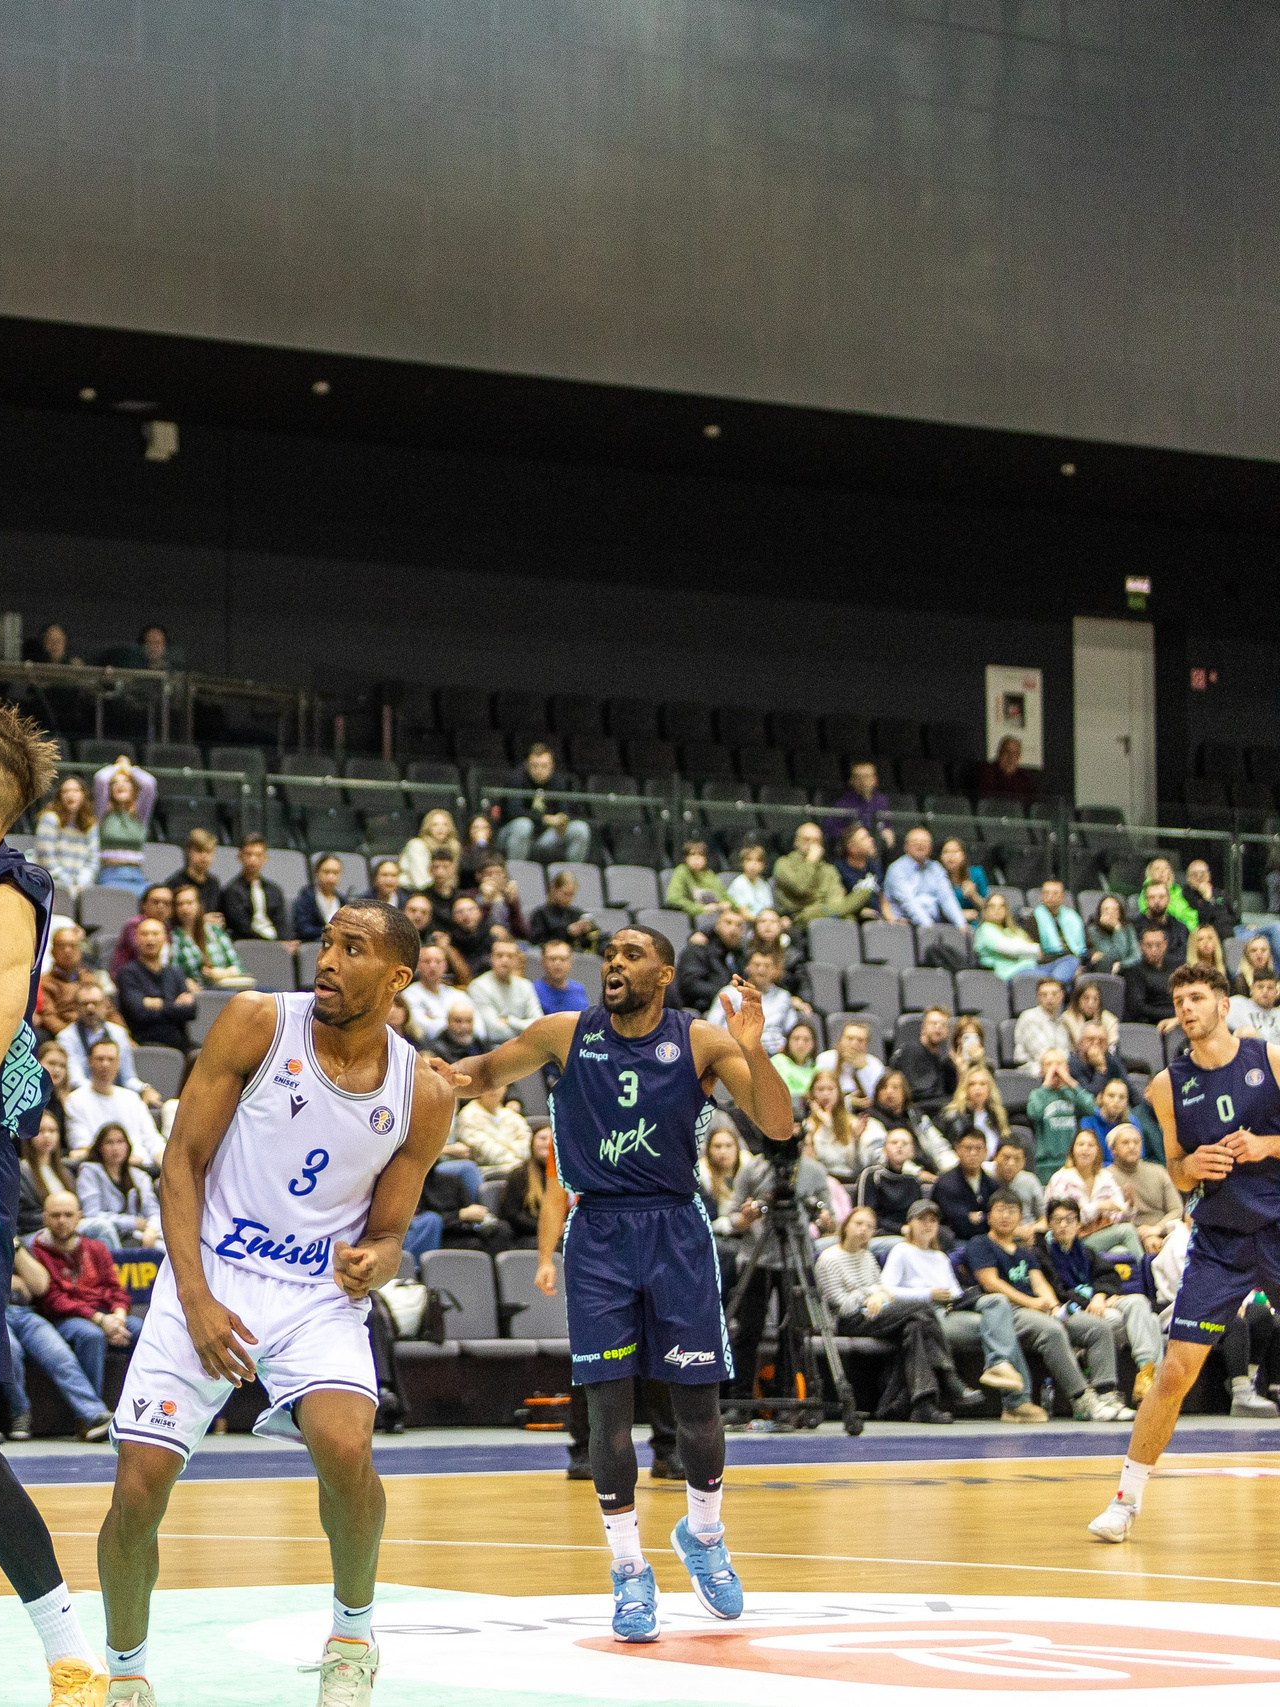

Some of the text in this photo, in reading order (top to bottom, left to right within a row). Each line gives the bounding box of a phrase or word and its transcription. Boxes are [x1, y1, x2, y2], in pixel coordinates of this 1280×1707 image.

[579, 1048, 609, 1062] Kempa
[273, 1075, 301, 1089] ENISEY
[617, 1070, 639, 1108] 3
[1216, 1094, 1236, 1124] 0
[287, 1148, 330, 1197] 3
[215, 1216, 332, 1276] Enisey
[114, 1261, 158, 1289] VIP
[572, 1352, 601, 1363] Kempa
[149, 1417, 177, 1428] ENISEY
